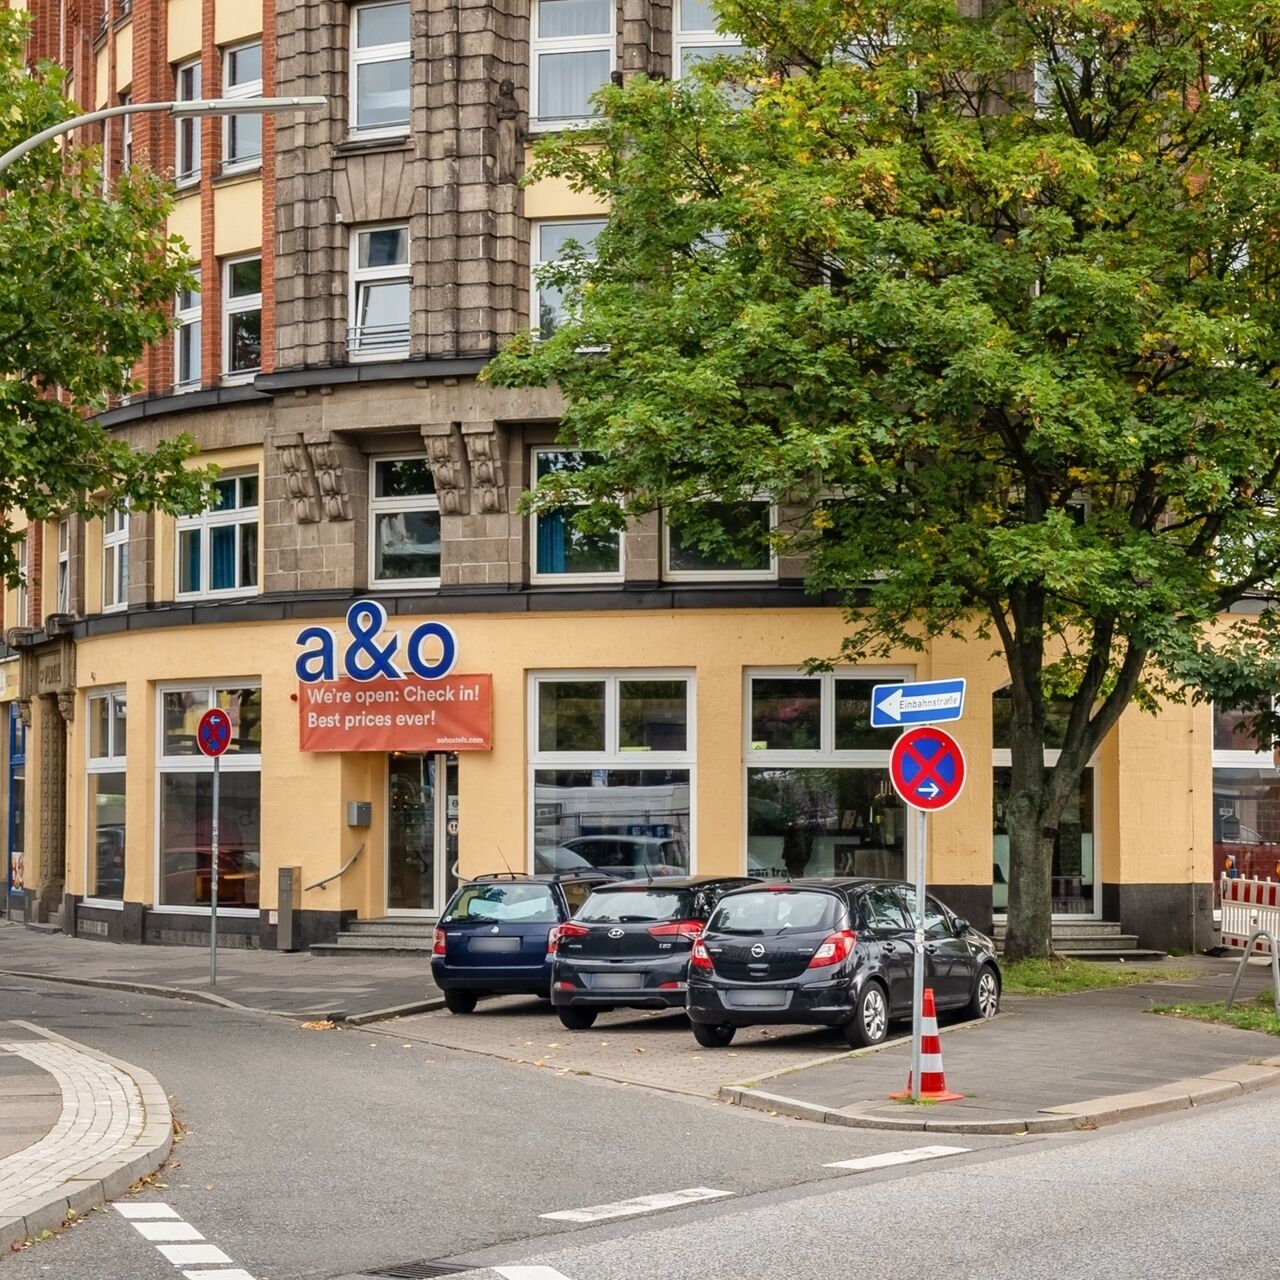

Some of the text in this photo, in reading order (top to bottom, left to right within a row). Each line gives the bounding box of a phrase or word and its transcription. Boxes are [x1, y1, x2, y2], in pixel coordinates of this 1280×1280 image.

[295, 600, 459, 683] a&o
[307, 685, 480, 705] We're open: Check in!
[900, 696, 958, 709] Einbahnstraße
[308, 710, 435, 730] Best prices ever!
